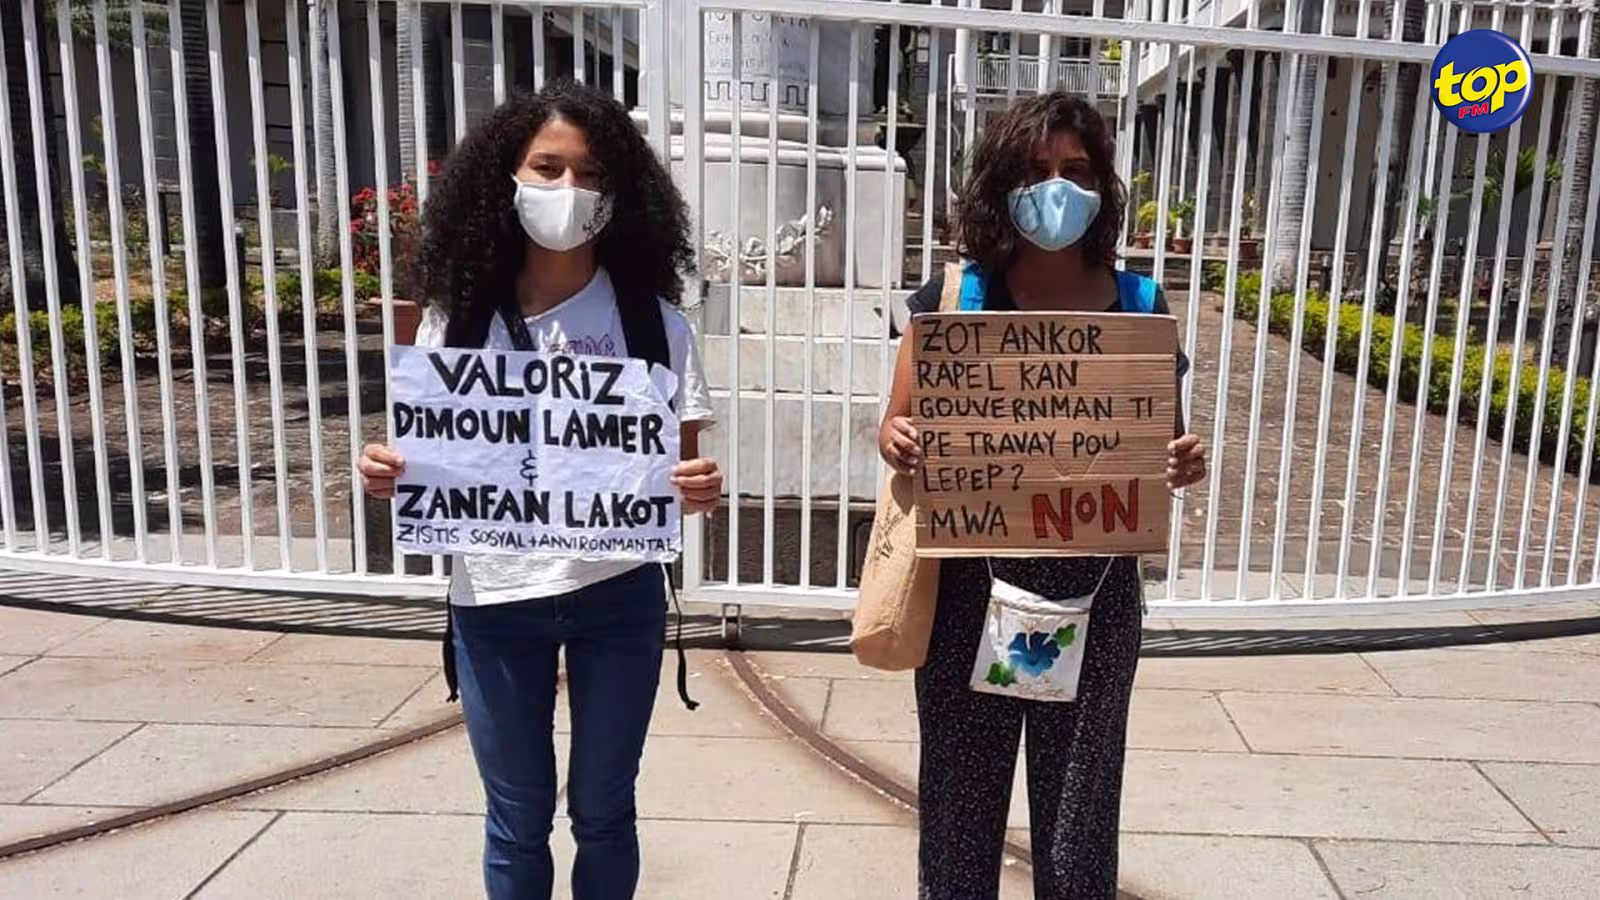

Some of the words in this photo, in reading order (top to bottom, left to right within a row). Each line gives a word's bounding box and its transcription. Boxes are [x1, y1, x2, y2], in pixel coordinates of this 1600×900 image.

[921, 319, 986, 354] ZOT
[1000, 322, 1102, 354] ANKOR
[917, 360, 1005, 391] RAPEL
[1020, 360, 1078, 391] KAN
[919, 396, 1112, 423] GOUVERNMAN
[1129, 396, 1152, 418] TI
[543, 409, 666, 455] LAMER
[922, 431, 952, 457] PE
[966, 430, 1056, 457] TRAVAY
[1073, 431, 1120, 457] POU
[397, 484, 550, 525] ZANFAN
[565, 491, 674, 528] LAKOT
[931, 501, 1008, 539] MWA
[396, 523, 460, 544] ZISTIS
